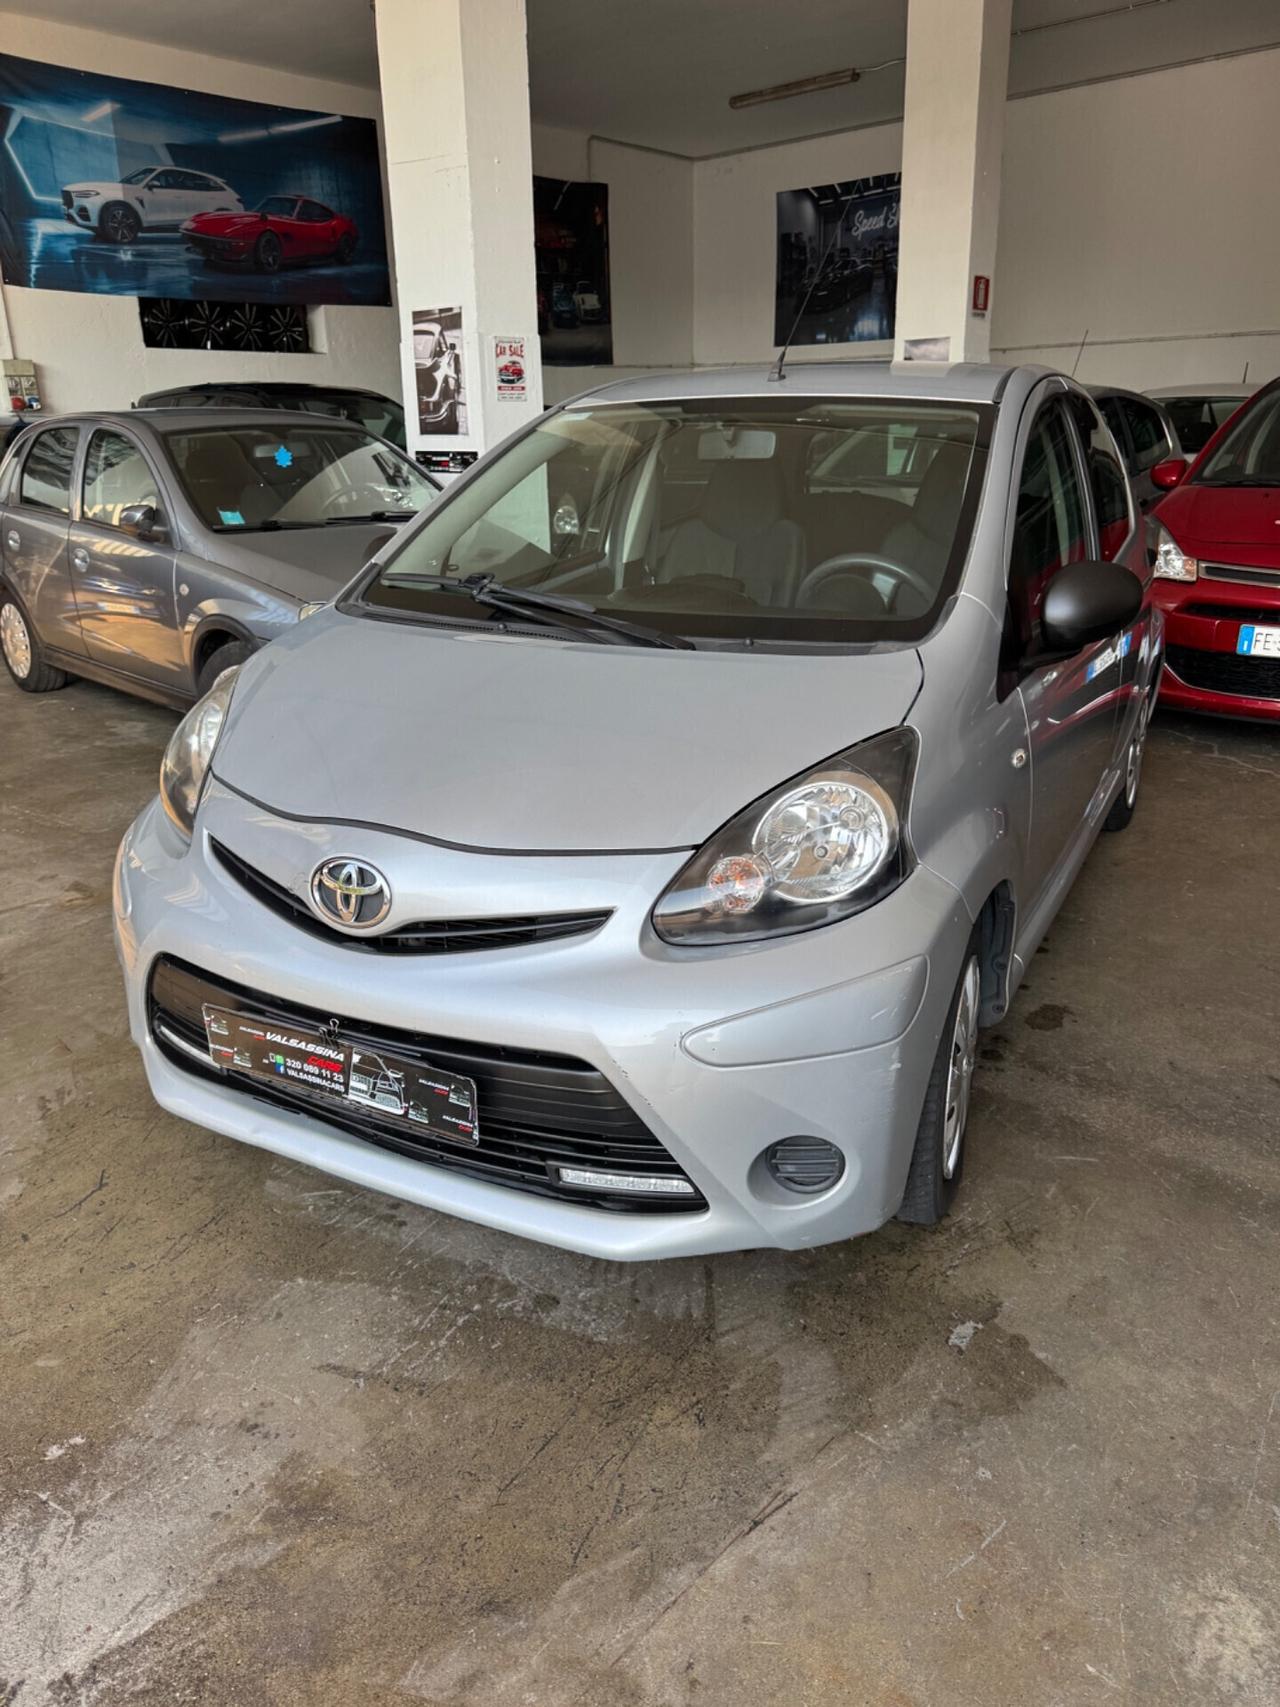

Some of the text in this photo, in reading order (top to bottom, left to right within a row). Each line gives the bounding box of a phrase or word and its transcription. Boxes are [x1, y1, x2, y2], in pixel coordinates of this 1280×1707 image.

[851, 206, 887, 240] Speed
[496, 343, 524, 358] CAR SALE
[266, 1031, 345, 1062] VALSASSINA
[285, 1058, 302, 1070] 320
[321, 1069, 331, 1079] 11
[333, 1073, 344, 1083] 23
[306, 1055, 344, 1073] CARS
